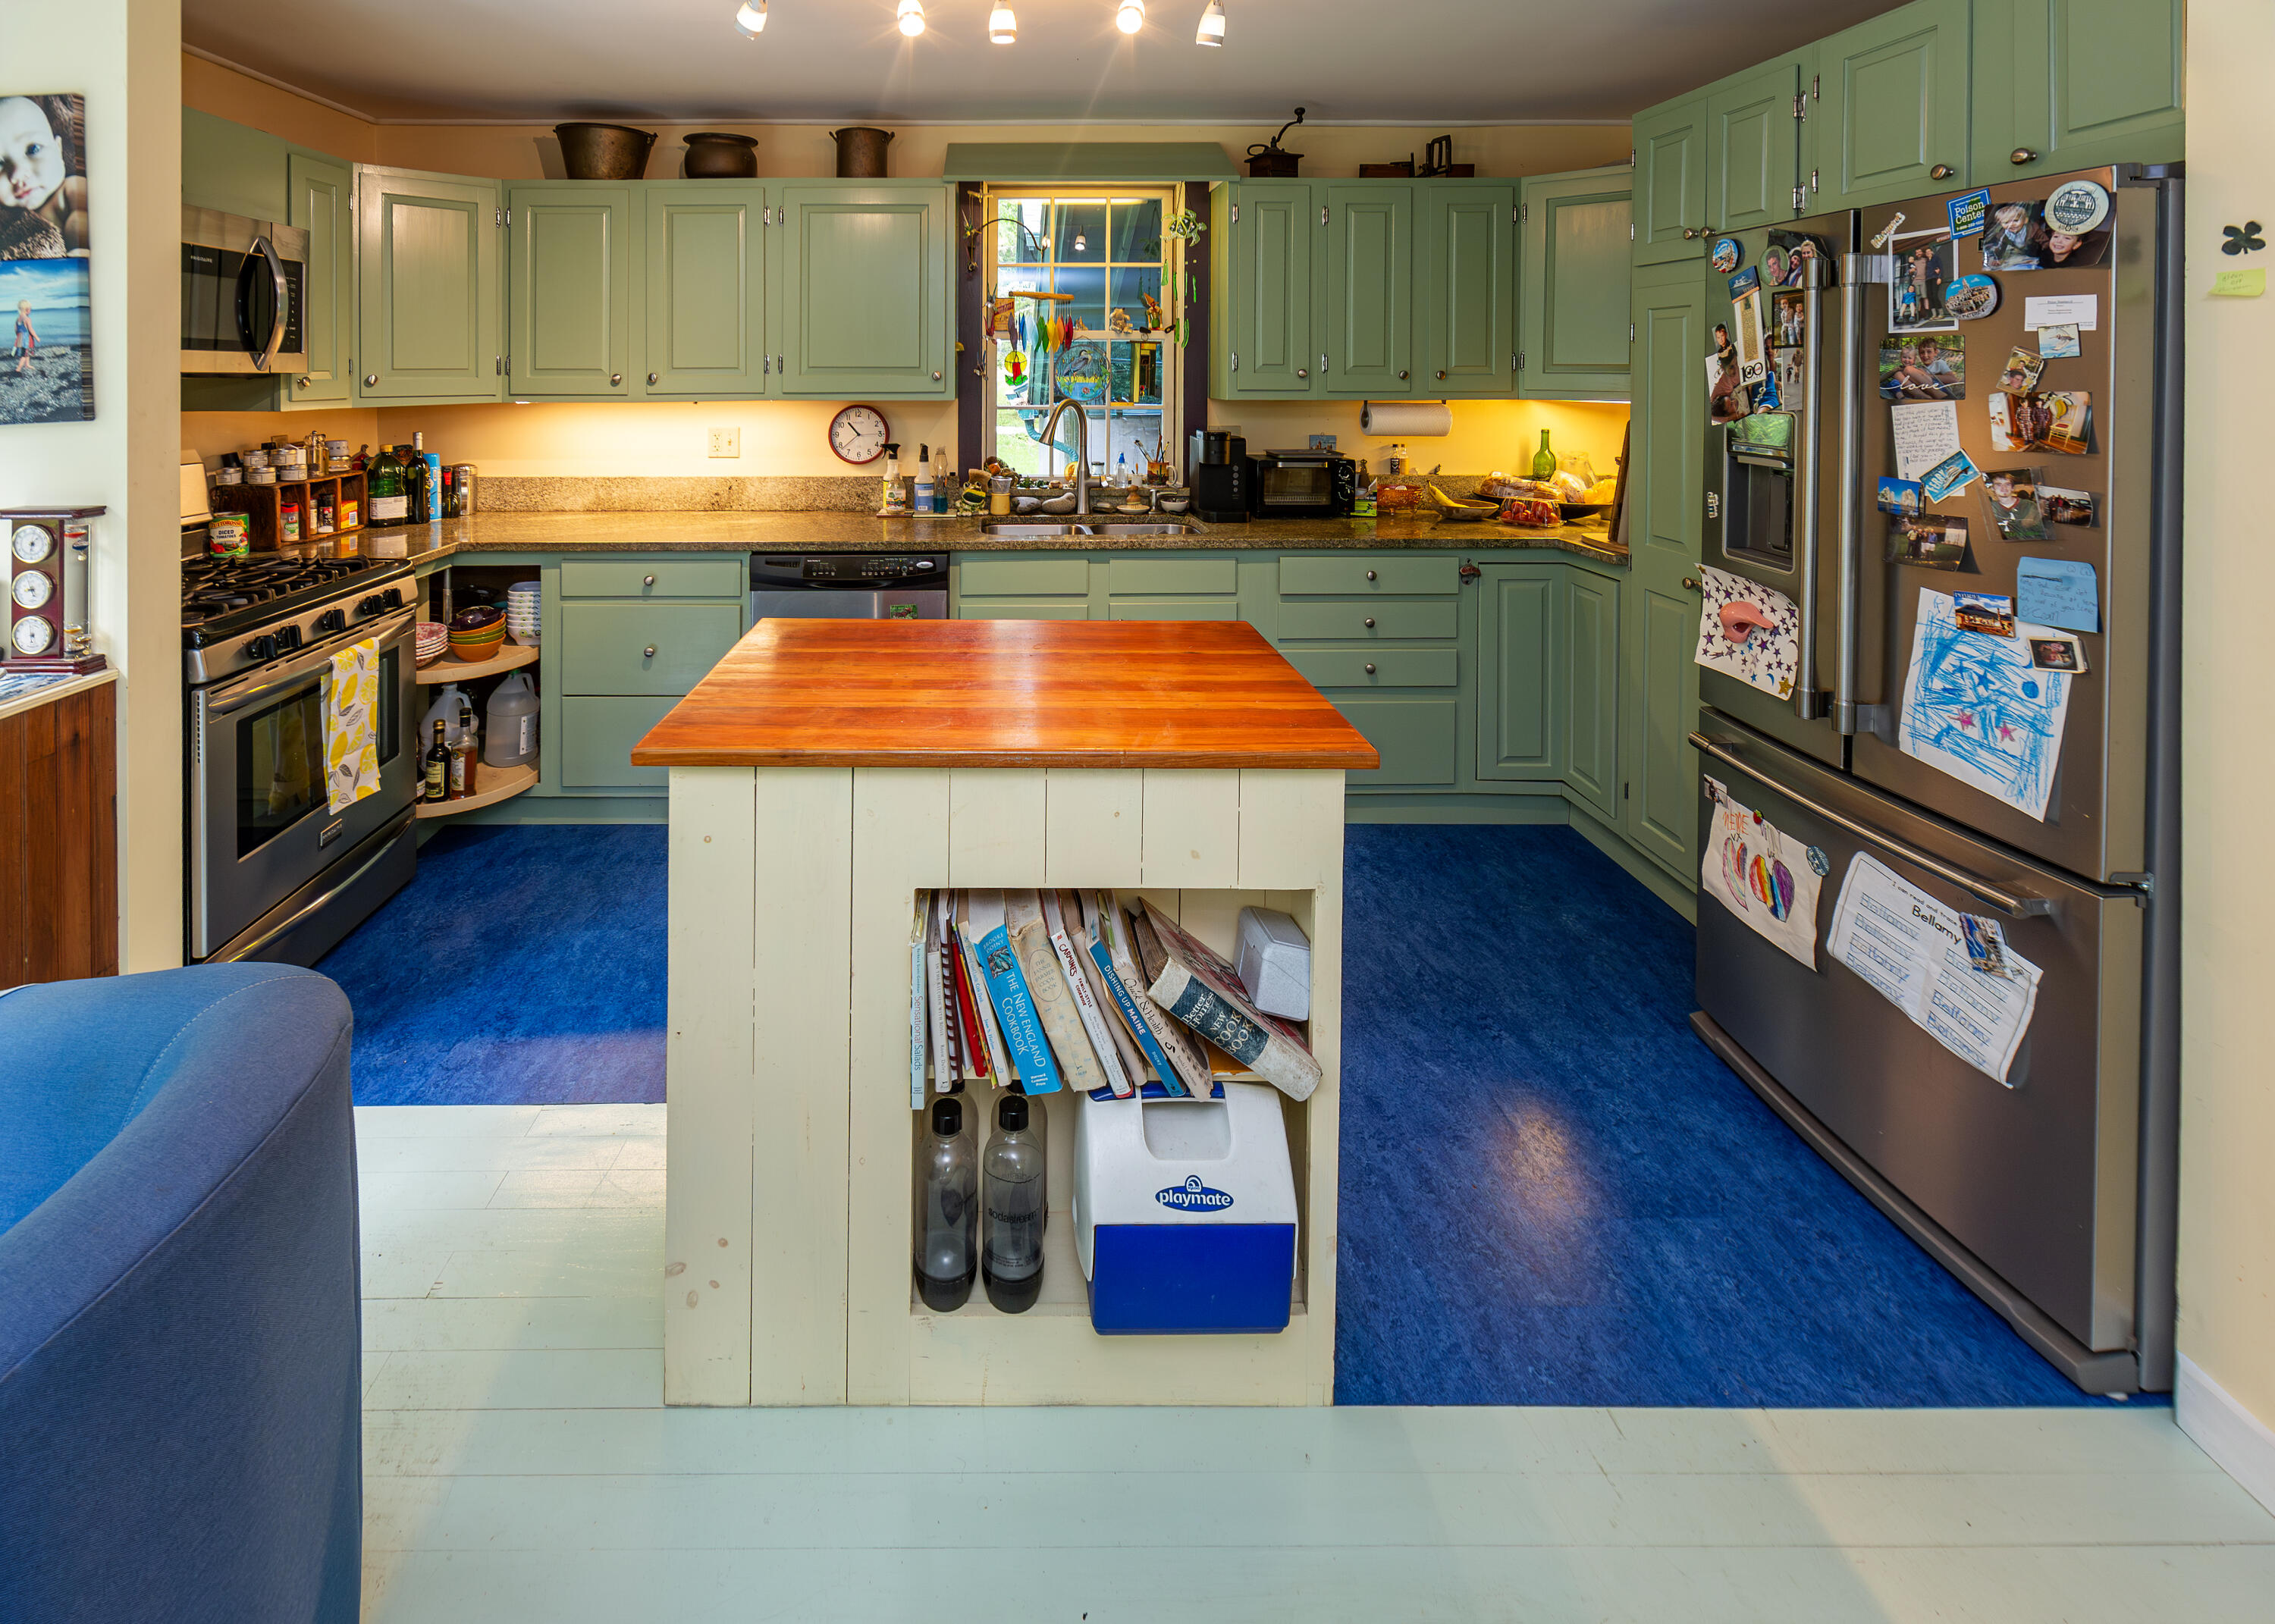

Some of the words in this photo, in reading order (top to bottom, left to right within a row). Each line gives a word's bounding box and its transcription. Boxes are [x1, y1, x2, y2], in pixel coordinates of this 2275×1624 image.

[1954, 202, 1985, 216] Poison
[1956, 209, 1985, 224] Center
[1741, 362, 1763, 383] 100
[1892, 375, 1953, 390] love
[1897, 886, 1909, 895] can
[1909, 893, 1925, 905] read
[1926, 904, 1938, 914] and
[1912, 904, 1962, 945] Bellamy
[983, 933, 1003, 949] BROOKE
[1006, 971, 1019, 992] THE
[1039, 977, 1055, 987] COOK
[1042, 982, 1057, 994] BOOK
[1078, 978, 1092, 1008] FAMILY-STYLE
[1012, 992, 1028, 1017] NEW
[1075, 984, 1087, 1006] COOKBOOK
[1104, 964, 1125, 997] DISHING
[1122, 996, 1131, 1007] UP
[1127, 1008, 1146, 1036] MAINE
[1123, 978, 1143, 1002] Quick
[1139, 1000, 1149, 1012] &
[914, 995, 923, 1043] Sensational
[1181, 993, 1207, 1024] Better
[1189, 992, 1214, 1028] Homes
[1209, 1011, 1227, 1031] NEW
[1002, 997, 1029, 1055] COOKBOOK
[1214, 1010, 1242, 1046] COOK
[1225, 1018, 1254, 1054] BOOK
[1021, 1019, 1046, 1068] ENGLAND
[914, 1044, 924, 1071] Salads
[1159, 1189, 1231, 1207] playmate
[988, 1208, 1038, 1224] sodastream
